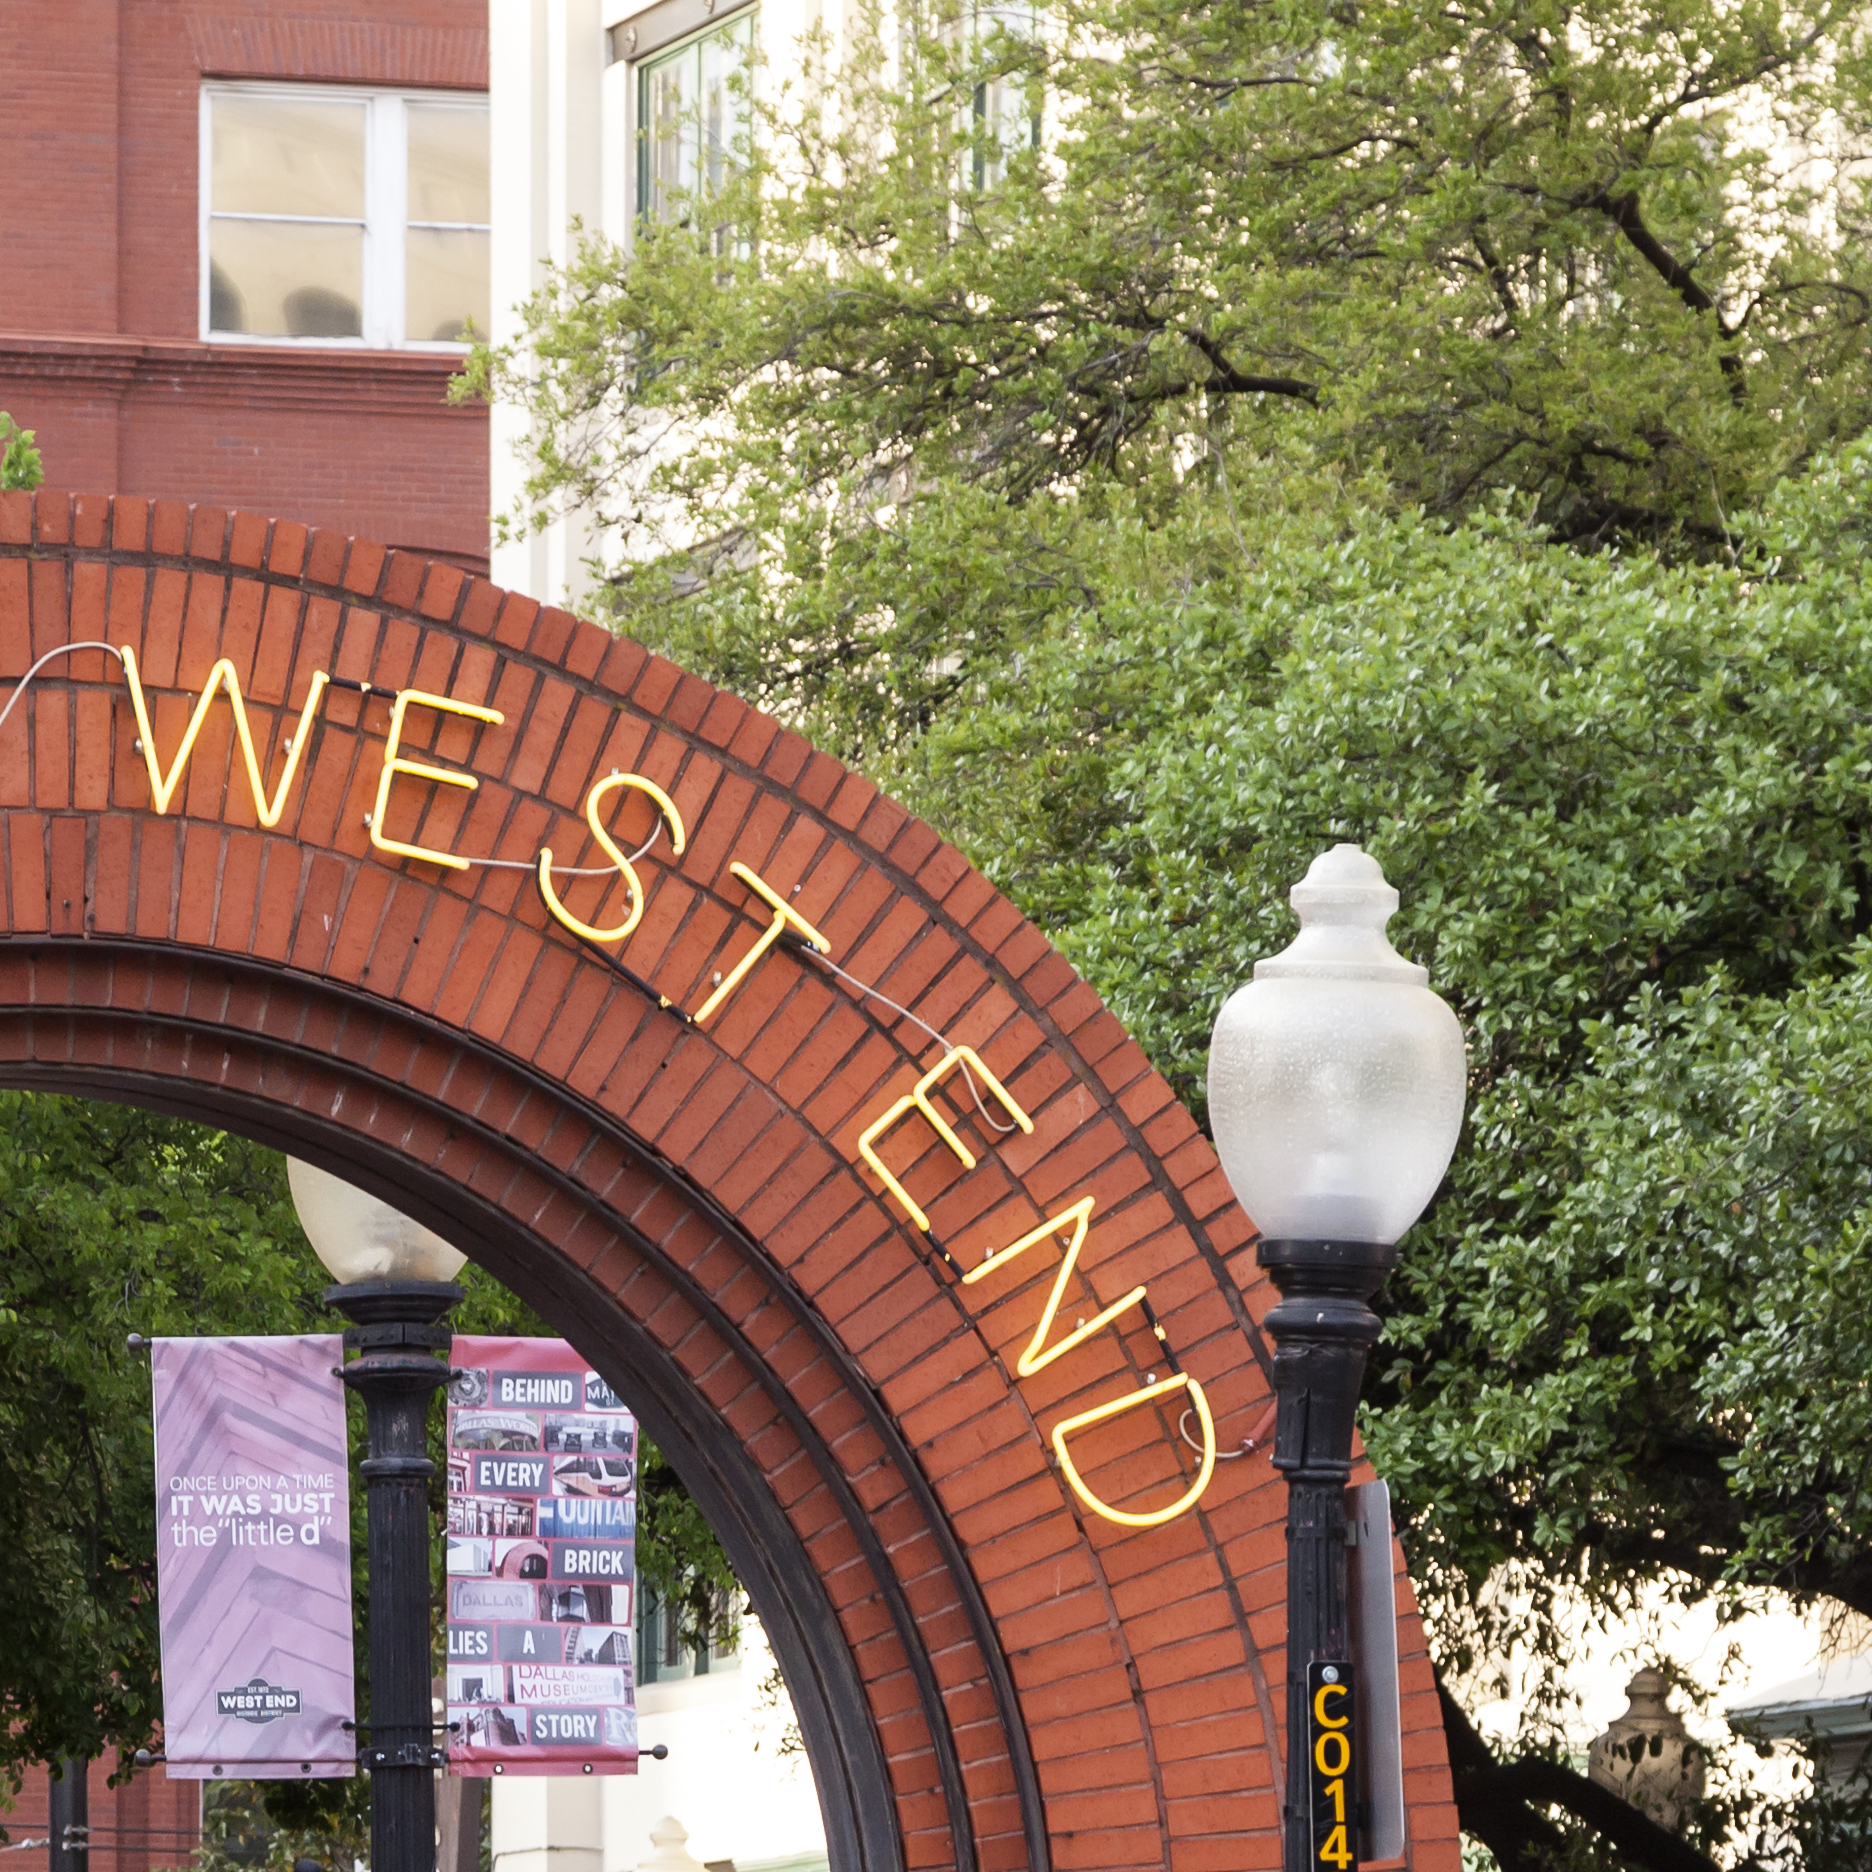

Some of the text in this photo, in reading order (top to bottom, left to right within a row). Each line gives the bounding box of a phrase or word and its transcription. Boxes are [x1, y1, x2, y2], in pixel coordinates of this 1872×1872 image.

[122, 644, 831, 1023] WEST
[859, 1045, 1216, 1527] END
[501, 1378, 573, 1404] BEHIND
[169, 1473, 334, 1492] ONCE UPON A TIME
[480, 1461, 544, 1488] EVERY
[171, 1492, 335, 1516] IT WAS JUST
[564, 1548, 624, 1575] BRICK
[462, 1594, 524, 1607] DALLAS
[448, 1630, 536, 1655] LIES A
[220, 1694, 297, 1709] WEST END
[535, 1714, 598, 1739] STORY
